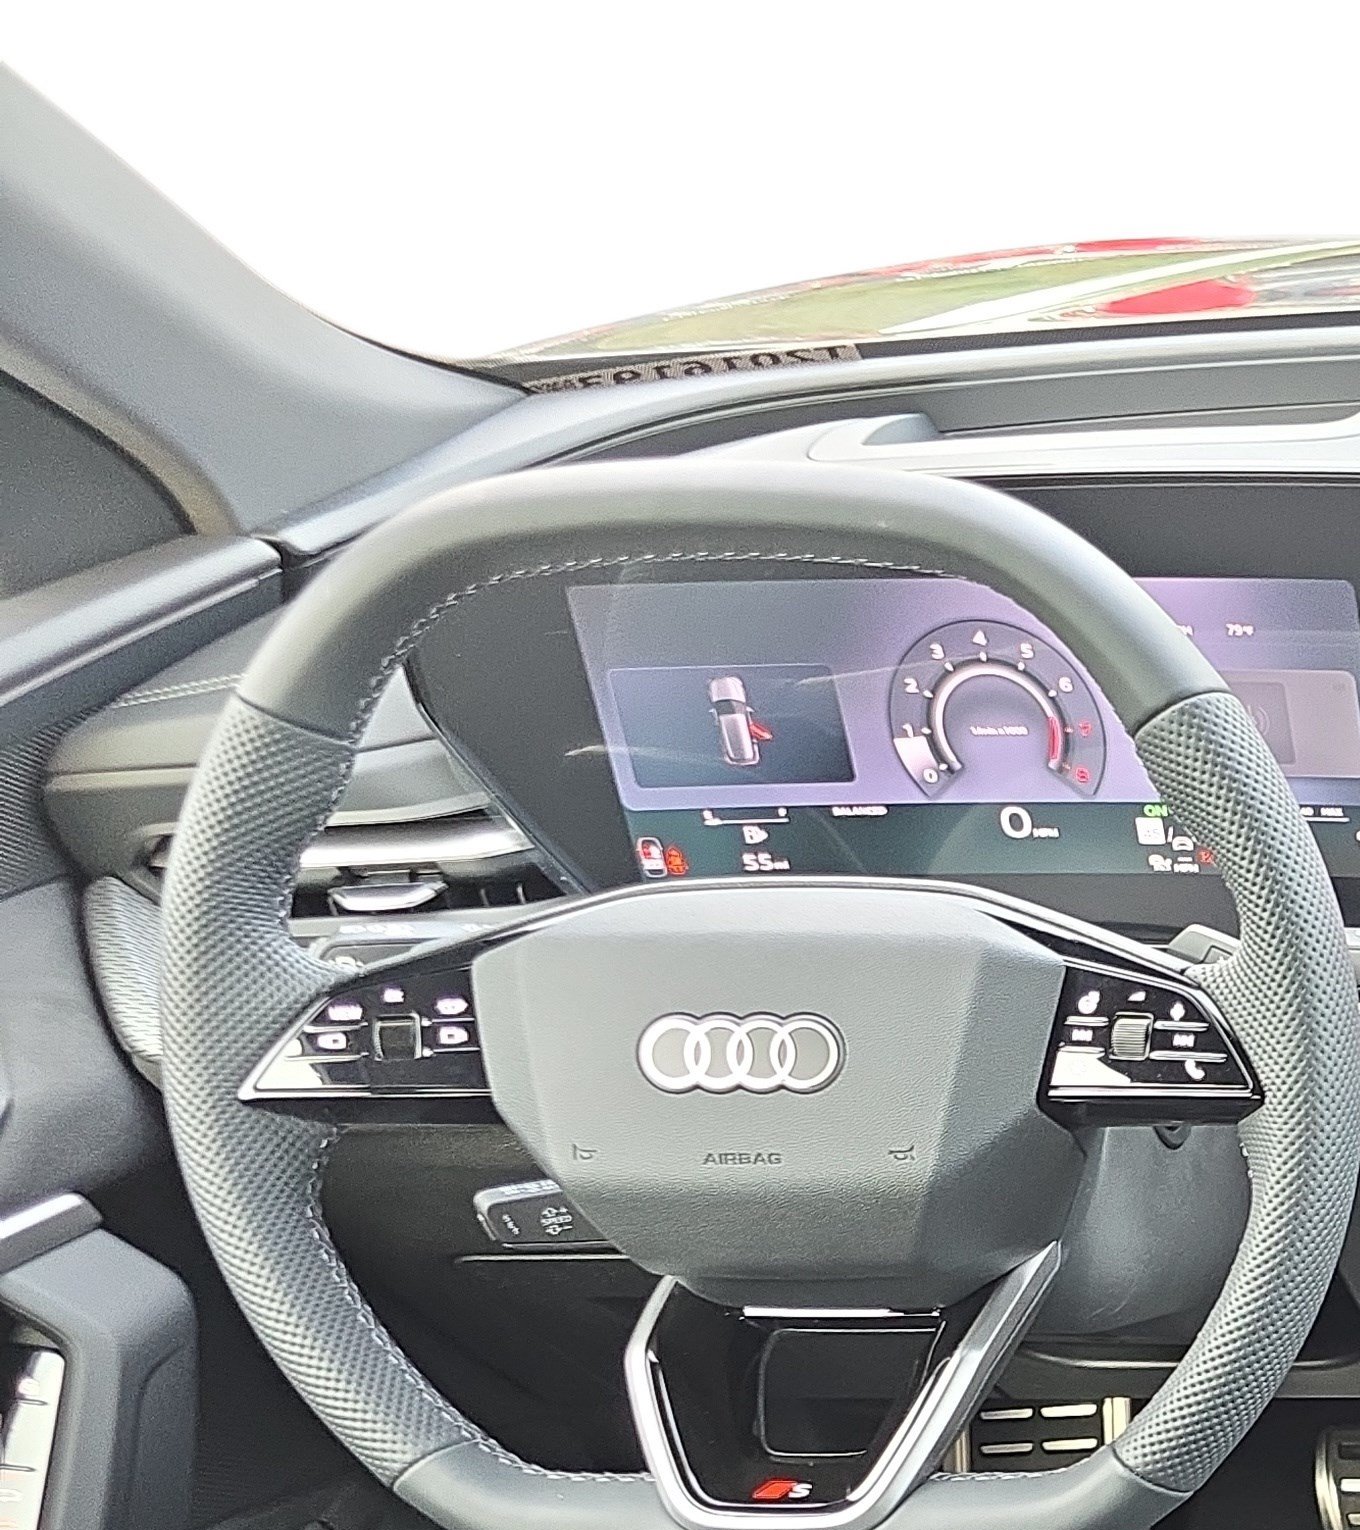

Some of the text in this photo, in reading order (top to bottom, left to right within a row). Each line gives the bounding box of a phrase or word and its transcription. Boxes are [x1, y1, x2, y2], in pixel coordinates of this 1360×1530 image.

[972, 630, 988, 646] 4
[929, 643, 944, 660] 3
[1020, 642, 1034, 659] 5
[903, 677, 919, 694] 2
[1058, 676, 1074, 693] 6
[922, 767, 940, 784] 0
[1143, 804, 1169, 818] ON
[1000, 805, 1033, 840] 0
[702, 1151, 784, 1166] AIRBAG
